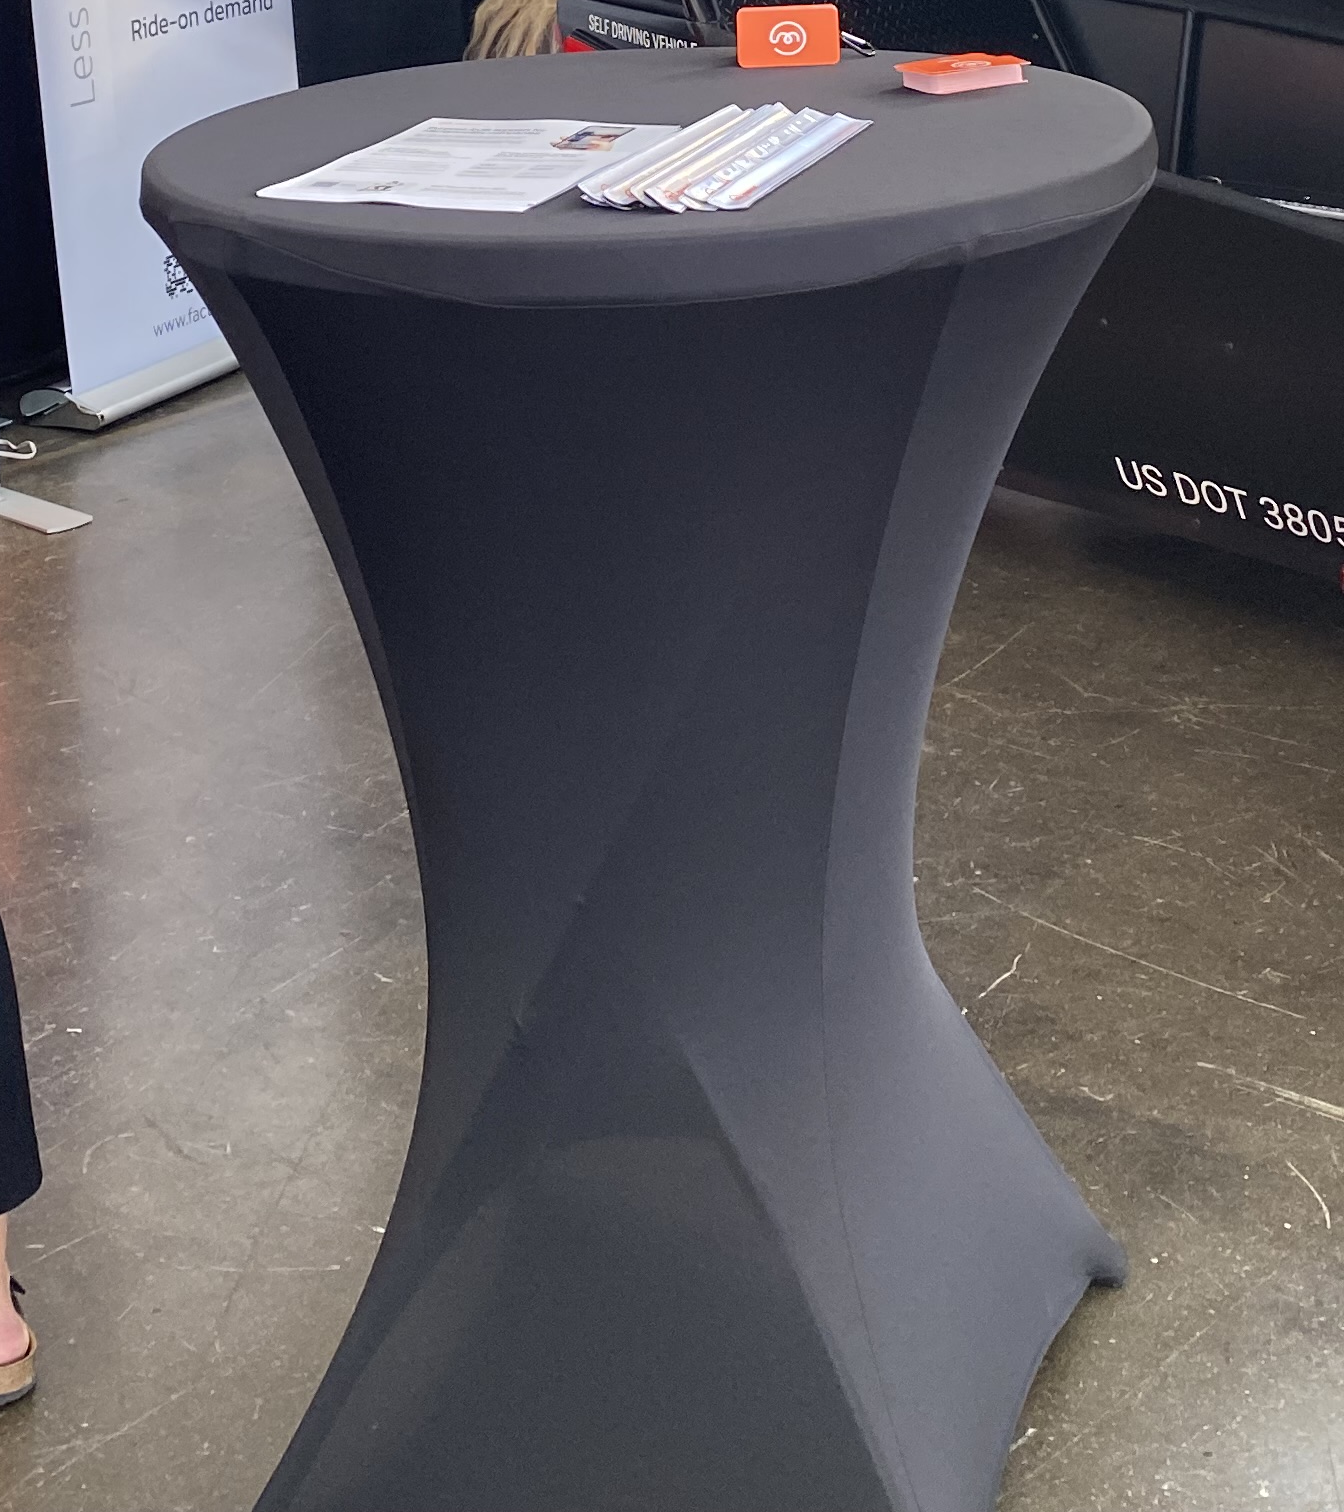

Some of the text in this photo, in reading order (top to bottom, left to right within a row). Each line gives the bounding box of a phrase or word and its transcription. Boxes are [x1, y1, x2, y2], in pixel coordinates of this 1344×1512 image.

[131, 10, 200, 42] Ride-on
[588, 14, 610, 36] SELF
[611, 21, 651, 48] DRIVING
[69, 7, 96, 108] Less
[1114, 456, 1168, 498] US
[1172, 471, 1247, 520] DOT
